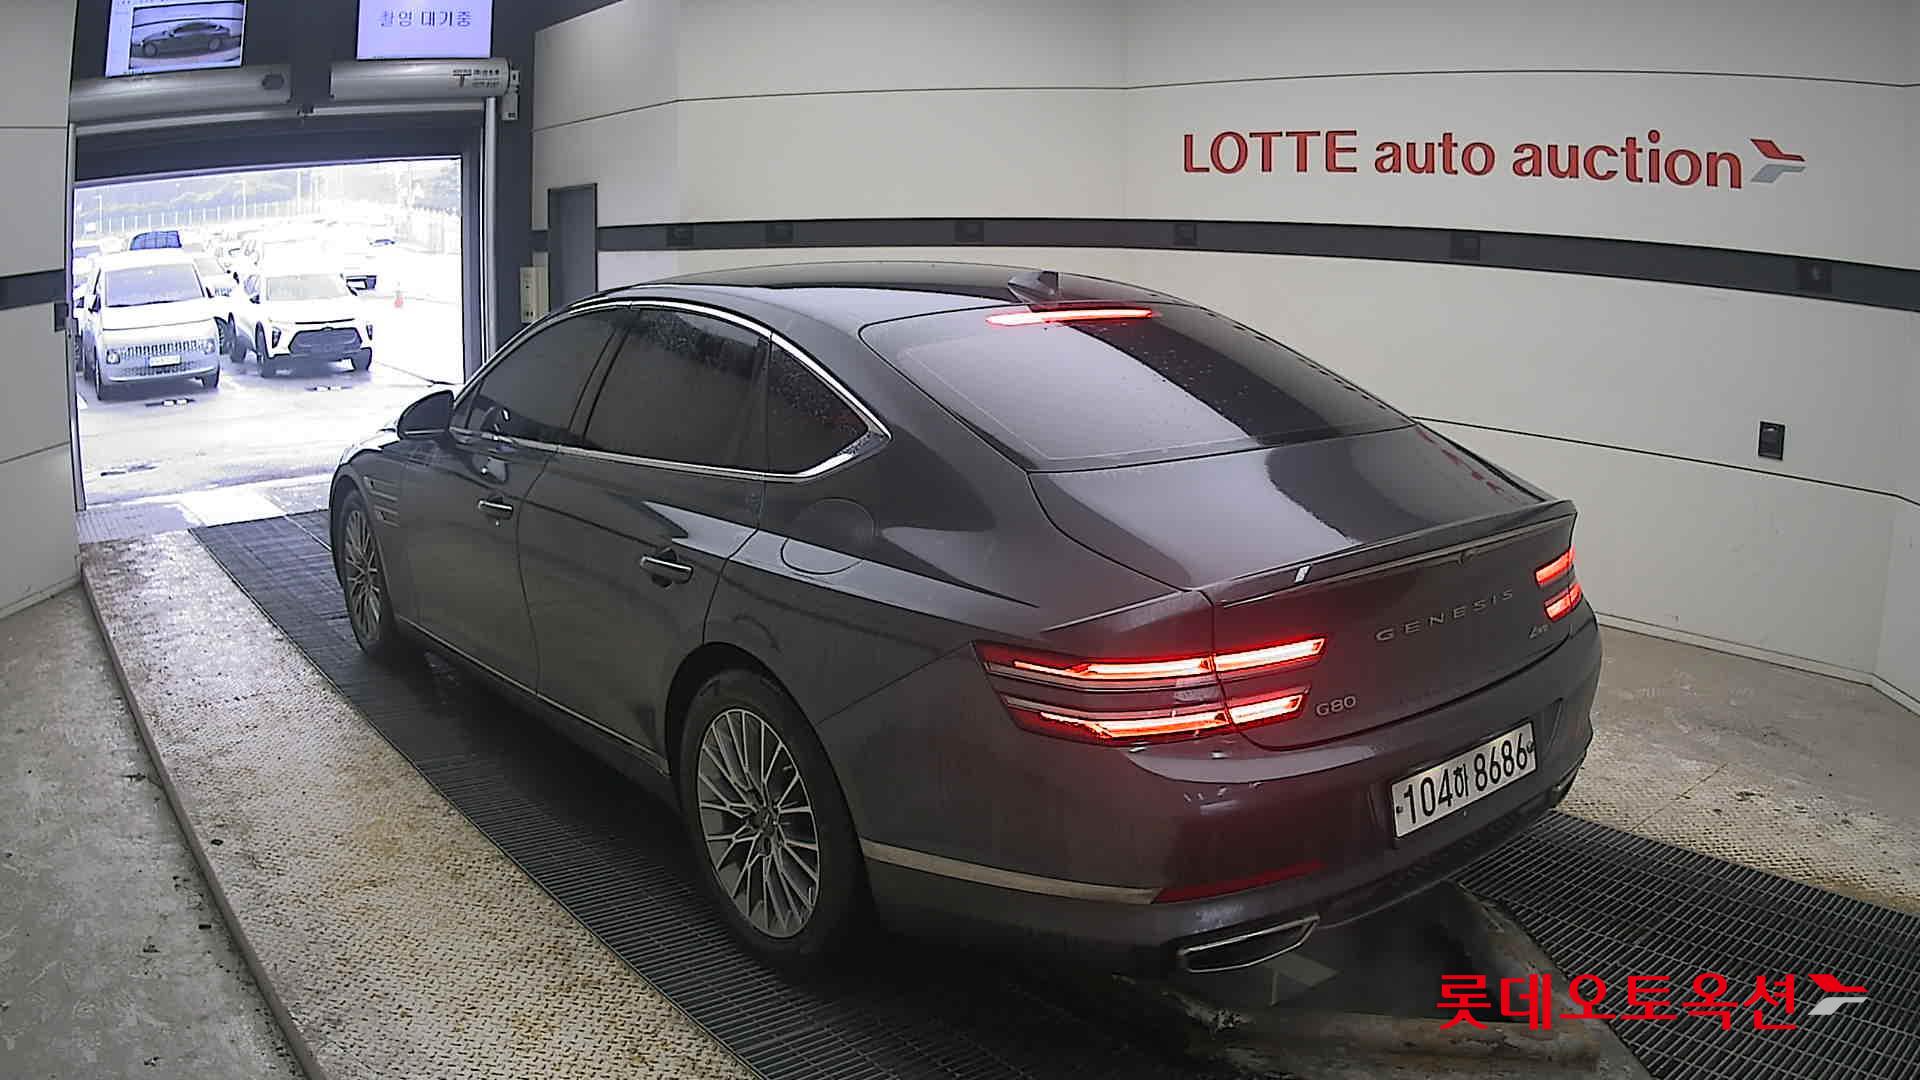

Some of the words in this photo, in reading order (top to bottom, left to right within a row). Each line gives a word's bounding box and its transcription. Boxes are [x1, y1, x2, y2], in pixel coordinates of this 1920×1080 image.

[421, 9, 472, 27] 대기중
[1183, 130, 1358, 174] LOTTE
[1374, 132, 1496, 177] auto
[1512, 130, 1744, 190] auction
[1375, 588, 1514, 642] GENESIS
[1315, 694, 1357, 717] G80
[1403, 763, 1469, 825] 104하
[1473, 733, 1528, 792] 8686
